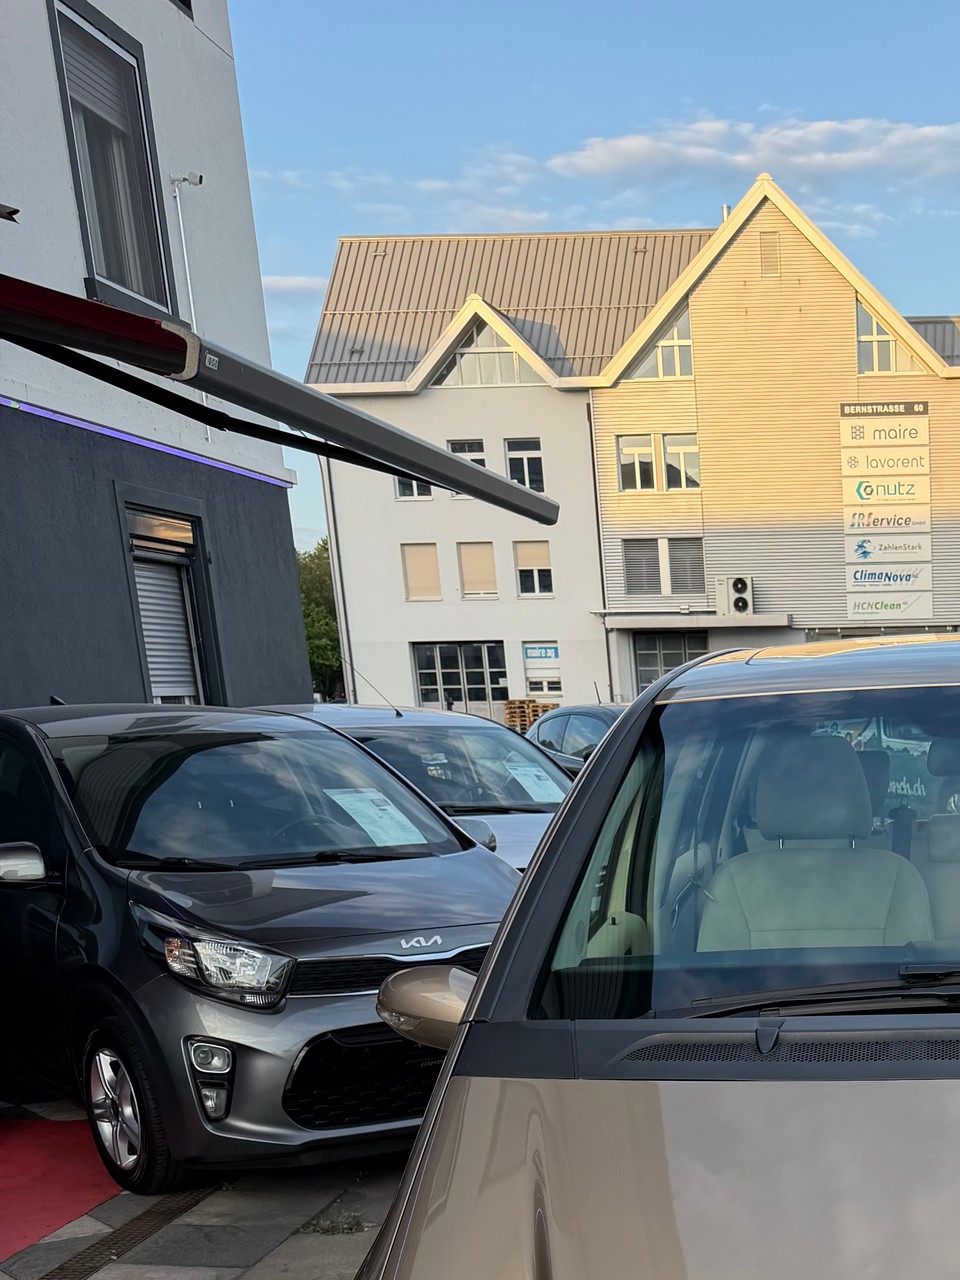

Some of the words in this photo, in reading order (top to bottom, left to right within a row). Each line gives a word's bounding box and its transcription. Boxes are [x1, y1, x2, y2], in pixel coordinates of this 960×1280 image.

[844, 404, 905, 414] BERNSTRASSE
[913, 404, 923, 412] 60
[873, 424, 919, 440] maire
[866, 455, 925, 469] lavorent
[879, 543, 922, 551] ZahlenStark
[853, 569, 912, 582] ClimaNova
[853, 601, 902, 611] HCNClean
